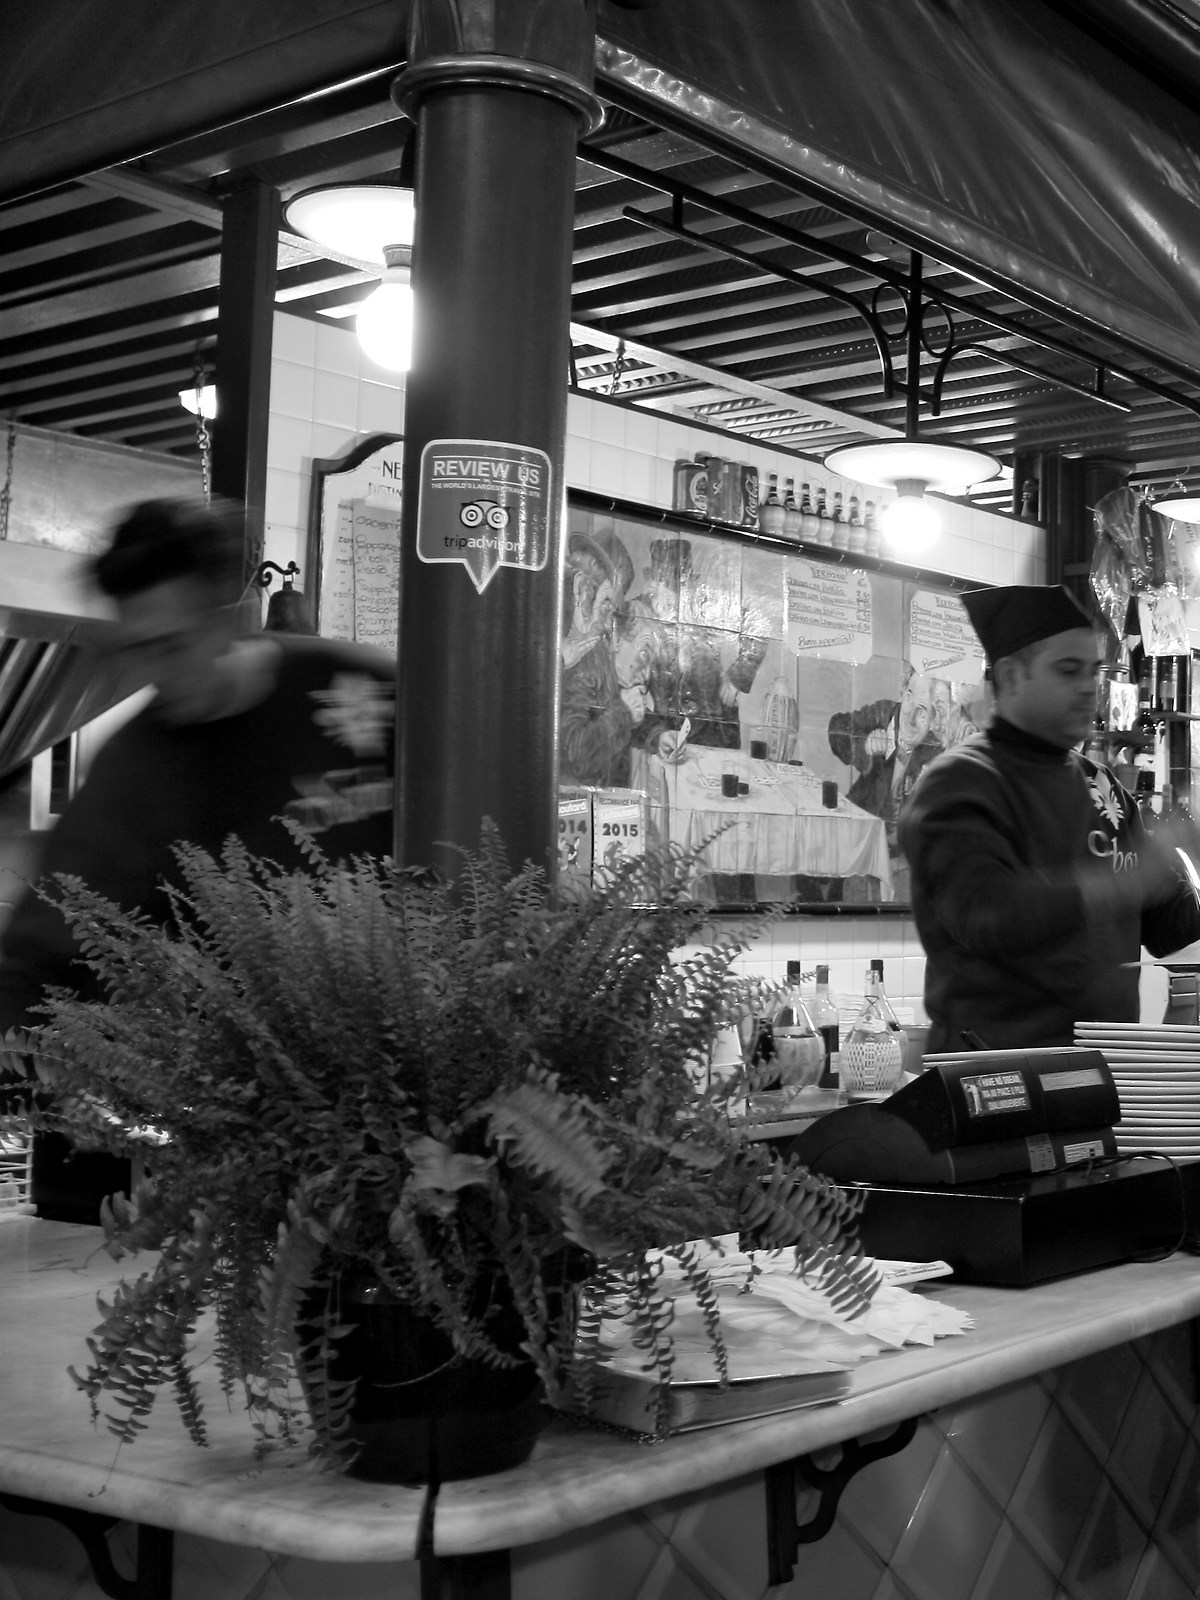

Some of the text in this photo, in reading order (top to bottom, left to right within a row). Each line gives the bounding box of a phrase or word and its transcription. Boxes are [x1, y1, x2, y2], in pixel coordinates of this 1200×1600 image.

[433, 460, 540, 485] REVIEW US
[602, 823, 638, 837] 2015
